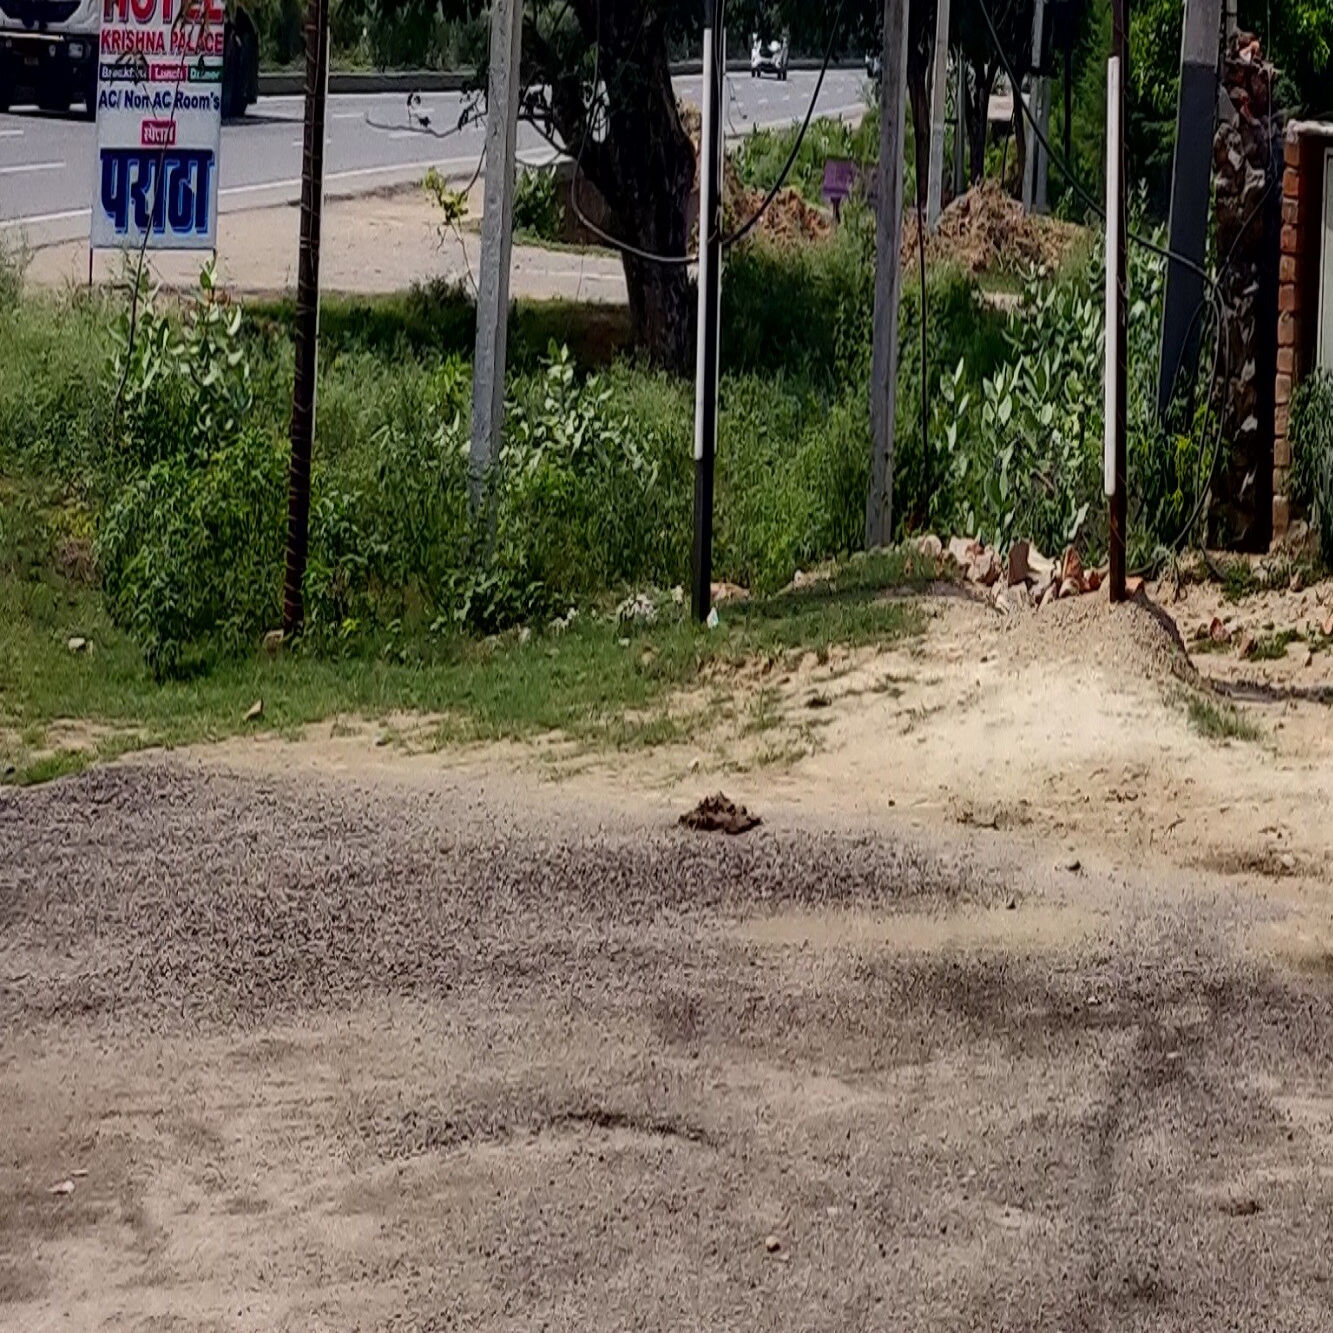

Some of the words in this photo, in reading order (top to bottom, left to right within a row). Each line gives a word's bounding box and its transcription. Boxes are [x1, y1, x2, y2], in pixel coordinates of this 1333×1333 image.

[101, 28, 165, 56] KRISHNA
[170, 30, 224, 57] PALACE
[98, 89, 122, 109] AC/
[124, 90, 151, 109] Non
[153, 90, 172, 109] AC
[174, 91, 221, 110] Room's
[100, 147, 216, 234] पराठा
